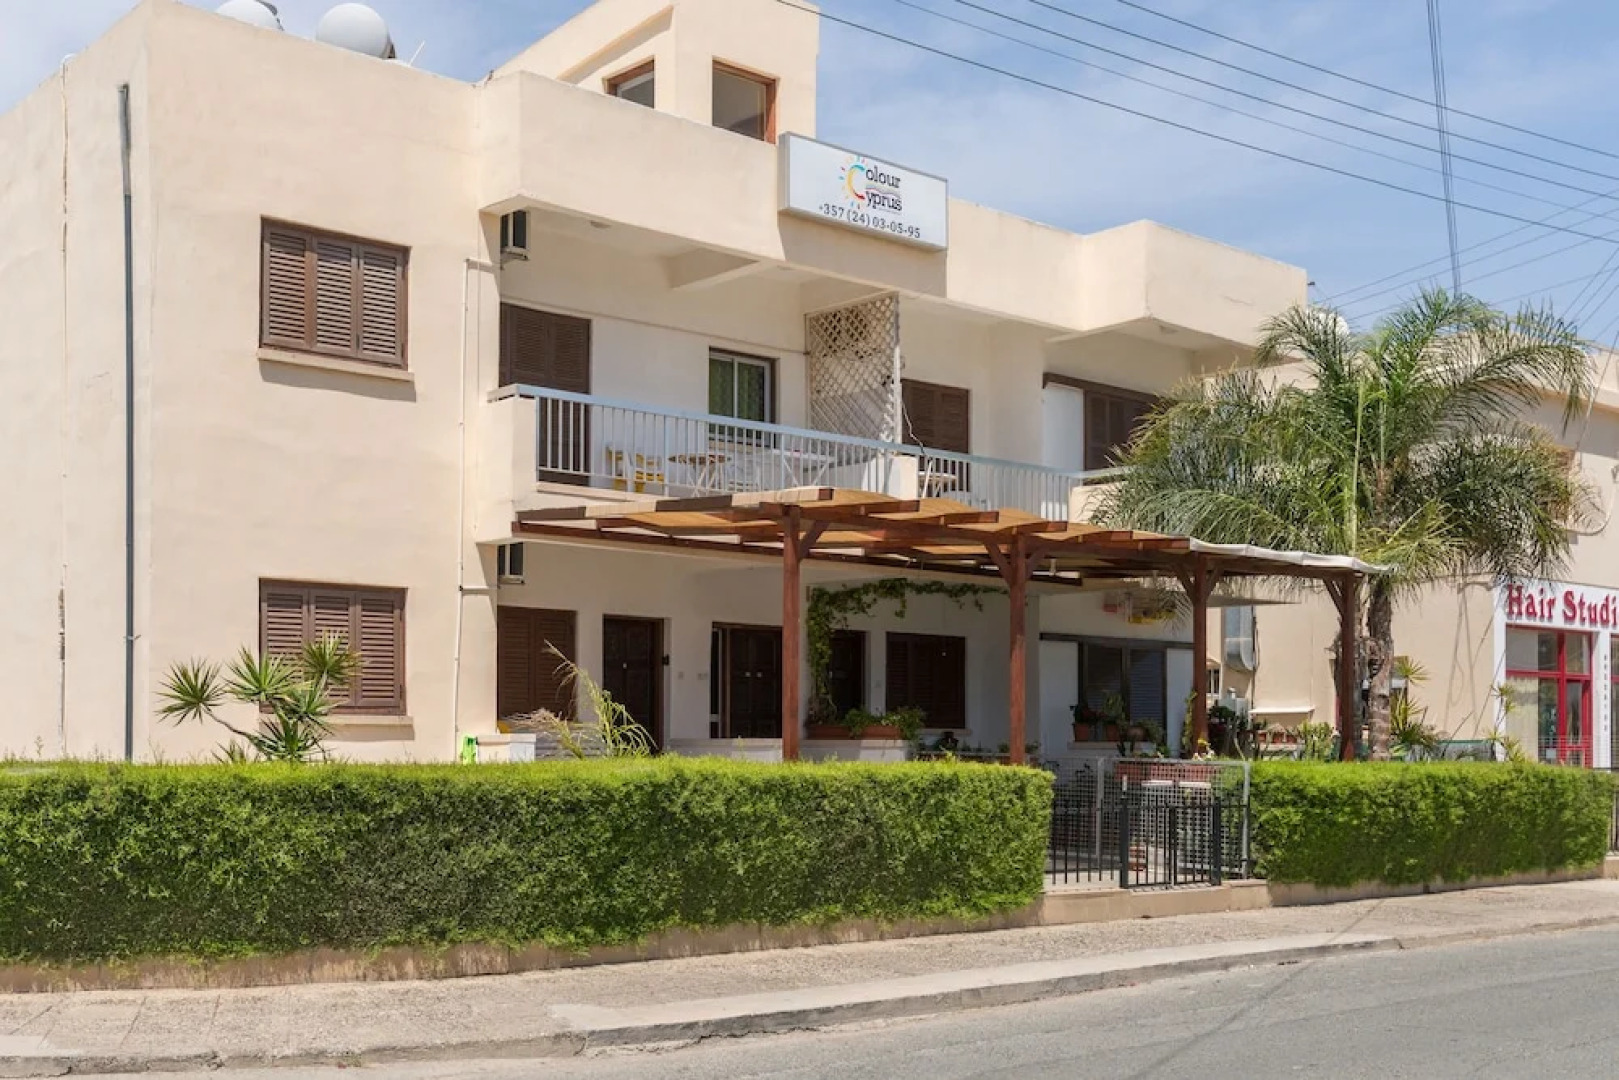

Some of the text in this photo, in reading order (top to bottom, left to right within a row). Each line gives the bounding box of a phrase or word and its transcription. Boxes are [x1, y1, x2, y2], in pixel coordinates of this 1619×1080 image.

[846, 209, 870, 227] (24)
[872, 216, 921, 239] 03-05-95
[1506, 584, 1556, 619] Hair
